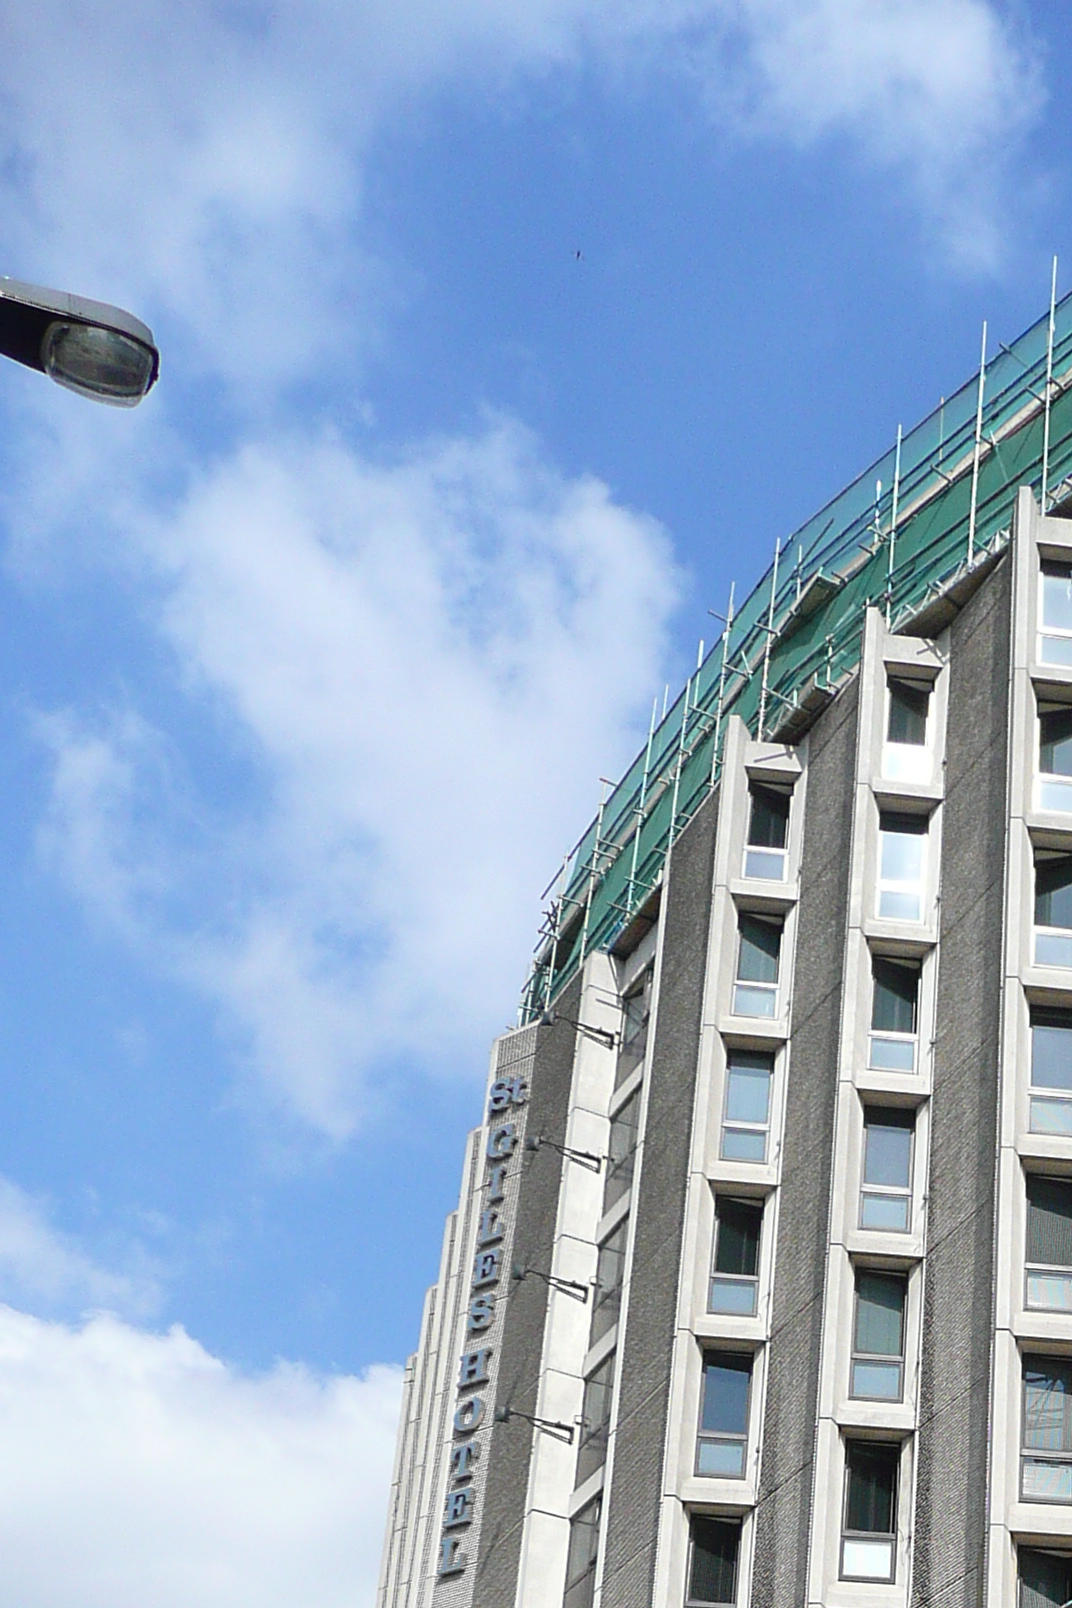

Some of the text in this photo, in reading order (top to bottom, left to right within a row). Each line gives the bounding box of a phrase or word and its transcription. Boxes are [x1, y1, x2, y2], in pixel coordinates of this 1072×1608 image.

[438, 1075, 529, 1577] St GILES HOTEL
